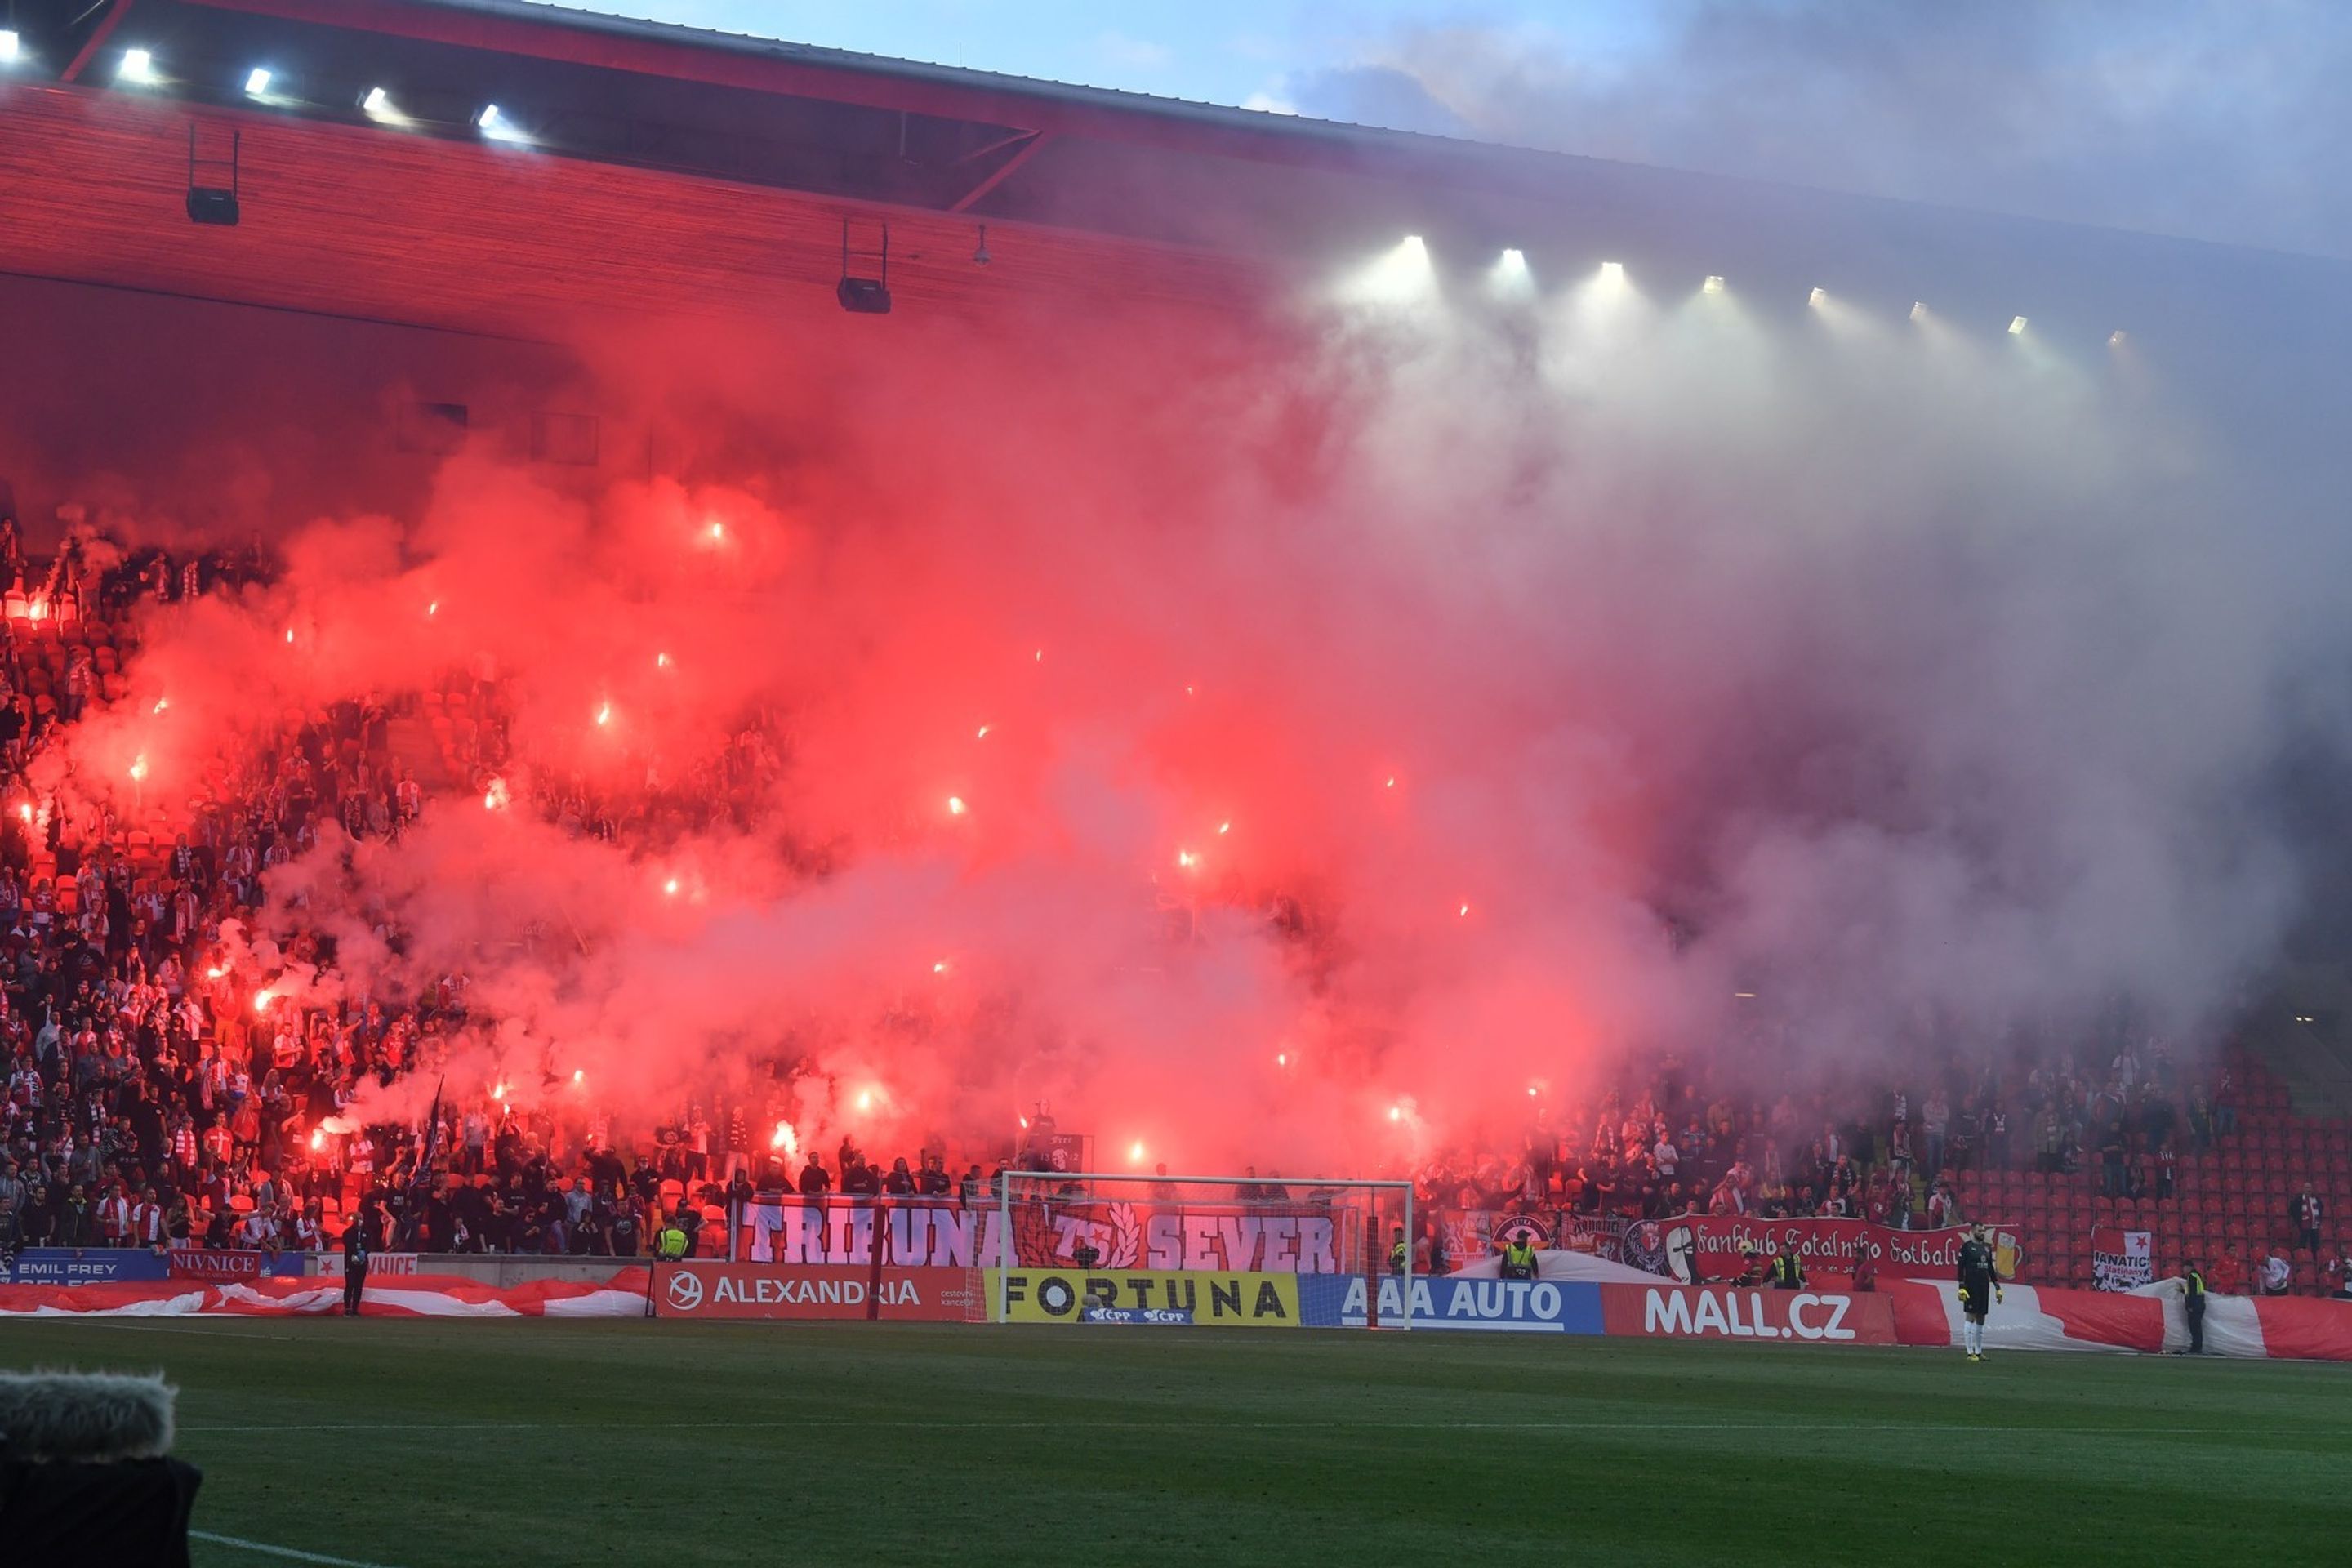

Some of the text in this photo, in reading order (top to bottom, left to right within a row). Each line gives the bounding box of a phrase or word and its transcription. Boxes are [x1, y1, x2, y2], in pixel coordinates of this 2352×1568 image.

[742, 1201, 1019, 1267] TRIBUNA
[1146, 1214, 1336, 1274] SEVER
[19, 1263, 63, 1274] EMIL
[67, 1264, 118, 1274] FREY
[172, 1254, 255, 1272] NIVNICE
[714, 1276, 920, 1305] ALEXANDRIA
[999, 1276, 1287, 1318] FORTUNA
[1342, 1278, 1561, 1320] AAA AUTO
[1106, 1307, 1130, 1321] ČPP
[1160, 1310, 1184, 1321] ČPP
[1645, 1288, 1855, 1339] MALL.CZ
